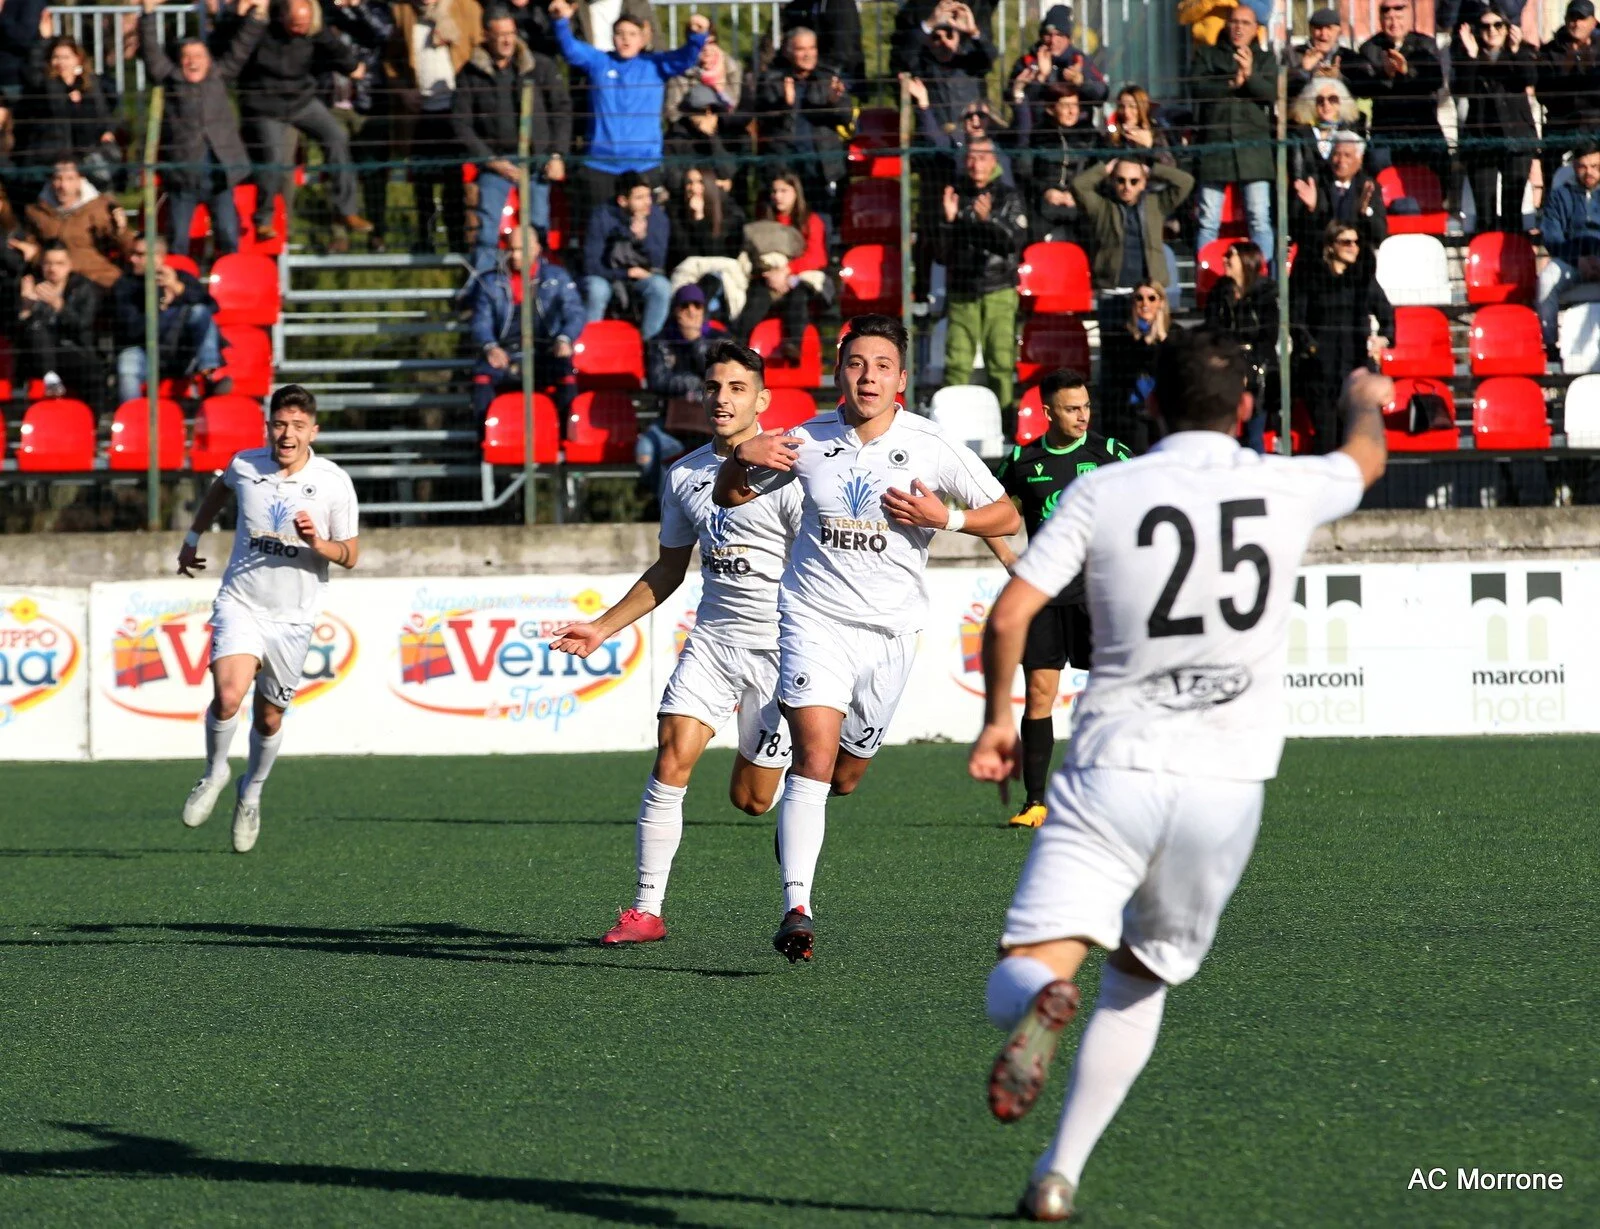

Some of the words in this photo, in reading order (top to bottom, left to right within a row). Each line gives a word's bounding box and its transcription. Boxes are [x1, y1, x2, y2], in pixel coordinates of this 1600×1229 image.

[835, 518, 872, 530] TERRA
[249, 537, 299, 558] PIERO
[820, 526, 888, 553] PIERO
[1136, 498, 1271, 638] 25
[1471, 663, 1565, 686] marconi
[509, 685, 577, 732] Top
[1472, 684, 1566, 723] hotel
[754, 729, 782, 758] 18
